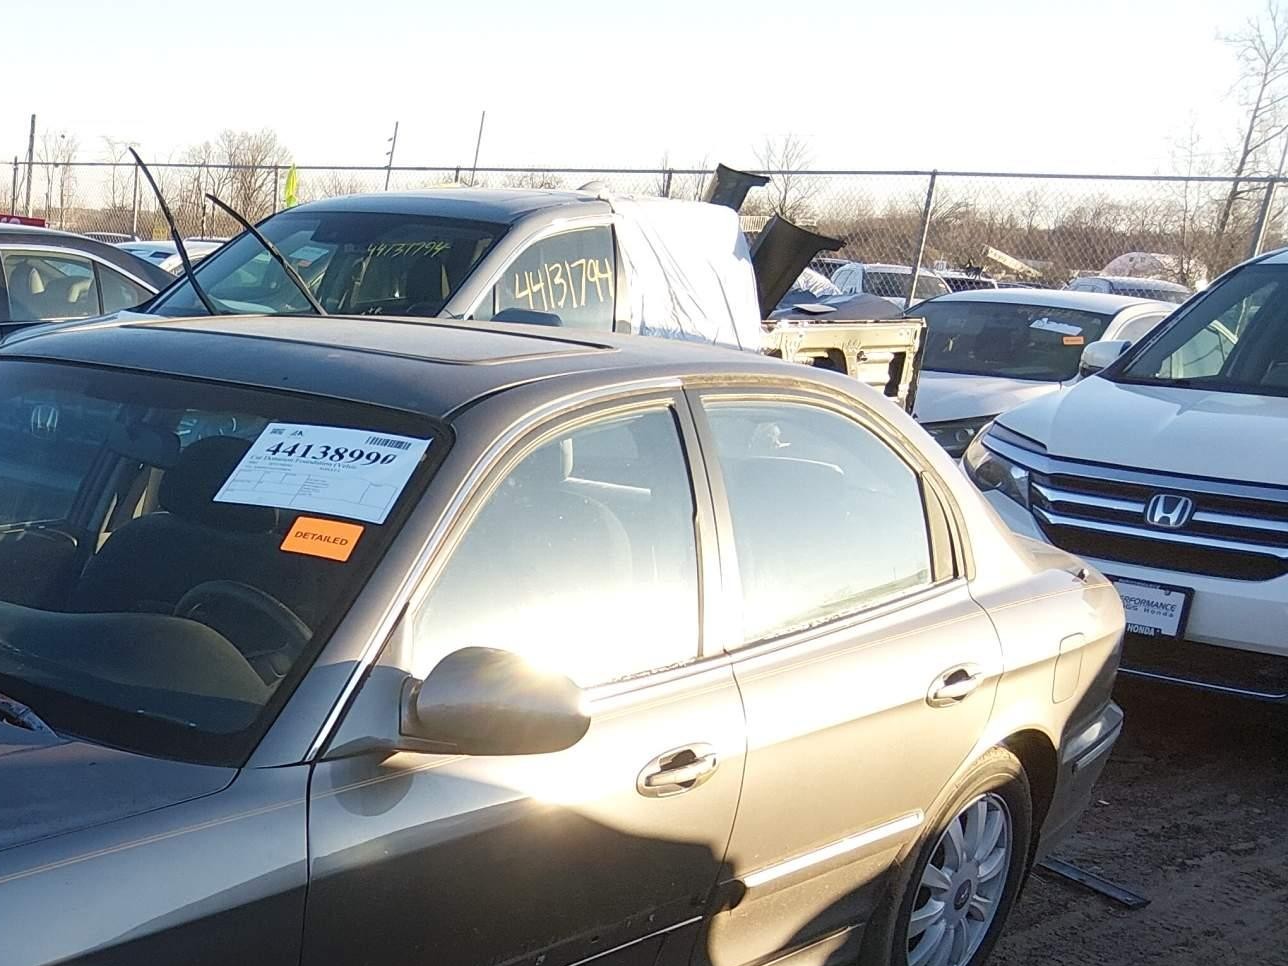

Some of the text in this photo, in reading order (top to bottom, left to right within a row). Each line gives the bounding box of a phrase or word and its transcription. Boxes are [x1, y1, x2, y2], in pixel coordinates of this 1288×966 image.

[515, 258, 613, 311] 44131794
[266, 441, 397, 466] 44138990
[294, 530, 349, 546] DETAILED
[1120, 594, 1177, 612] ERFORMANCE
[1127, 624, 1155, 636] HONDA
